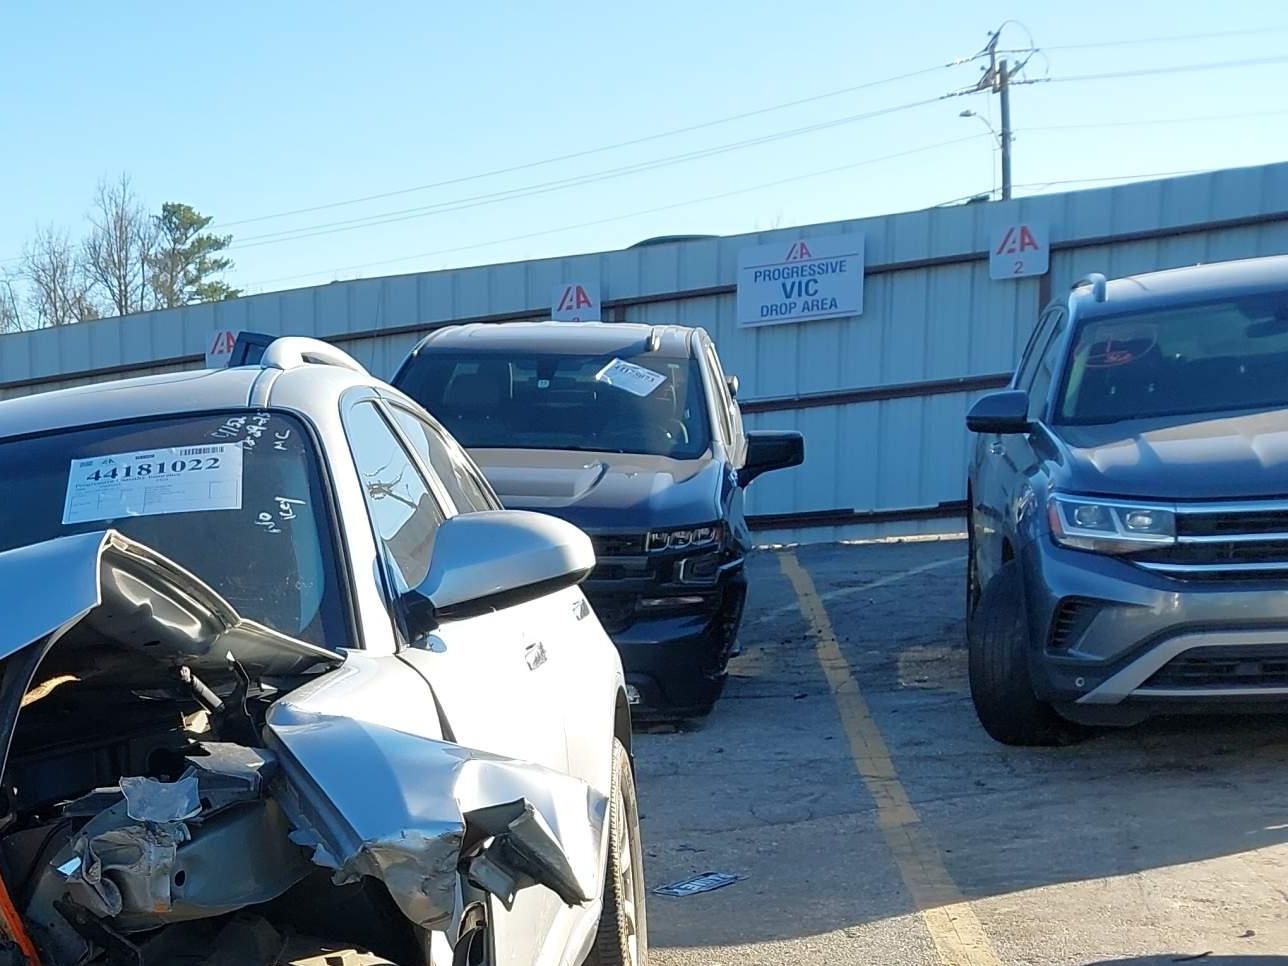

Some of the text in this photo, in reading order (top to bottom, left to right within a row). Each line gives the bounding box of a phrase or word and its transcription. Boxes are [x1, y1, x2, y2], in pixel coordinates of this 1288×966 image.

[753, 260, 848, 283] PROGRESSIVE
[1013, 260, 1024, 274] 2
[781, 278, 819, 300] VIC
[759, 297, 839, 318] DROP AREA
[86, 457, 221, 482] 44181022
